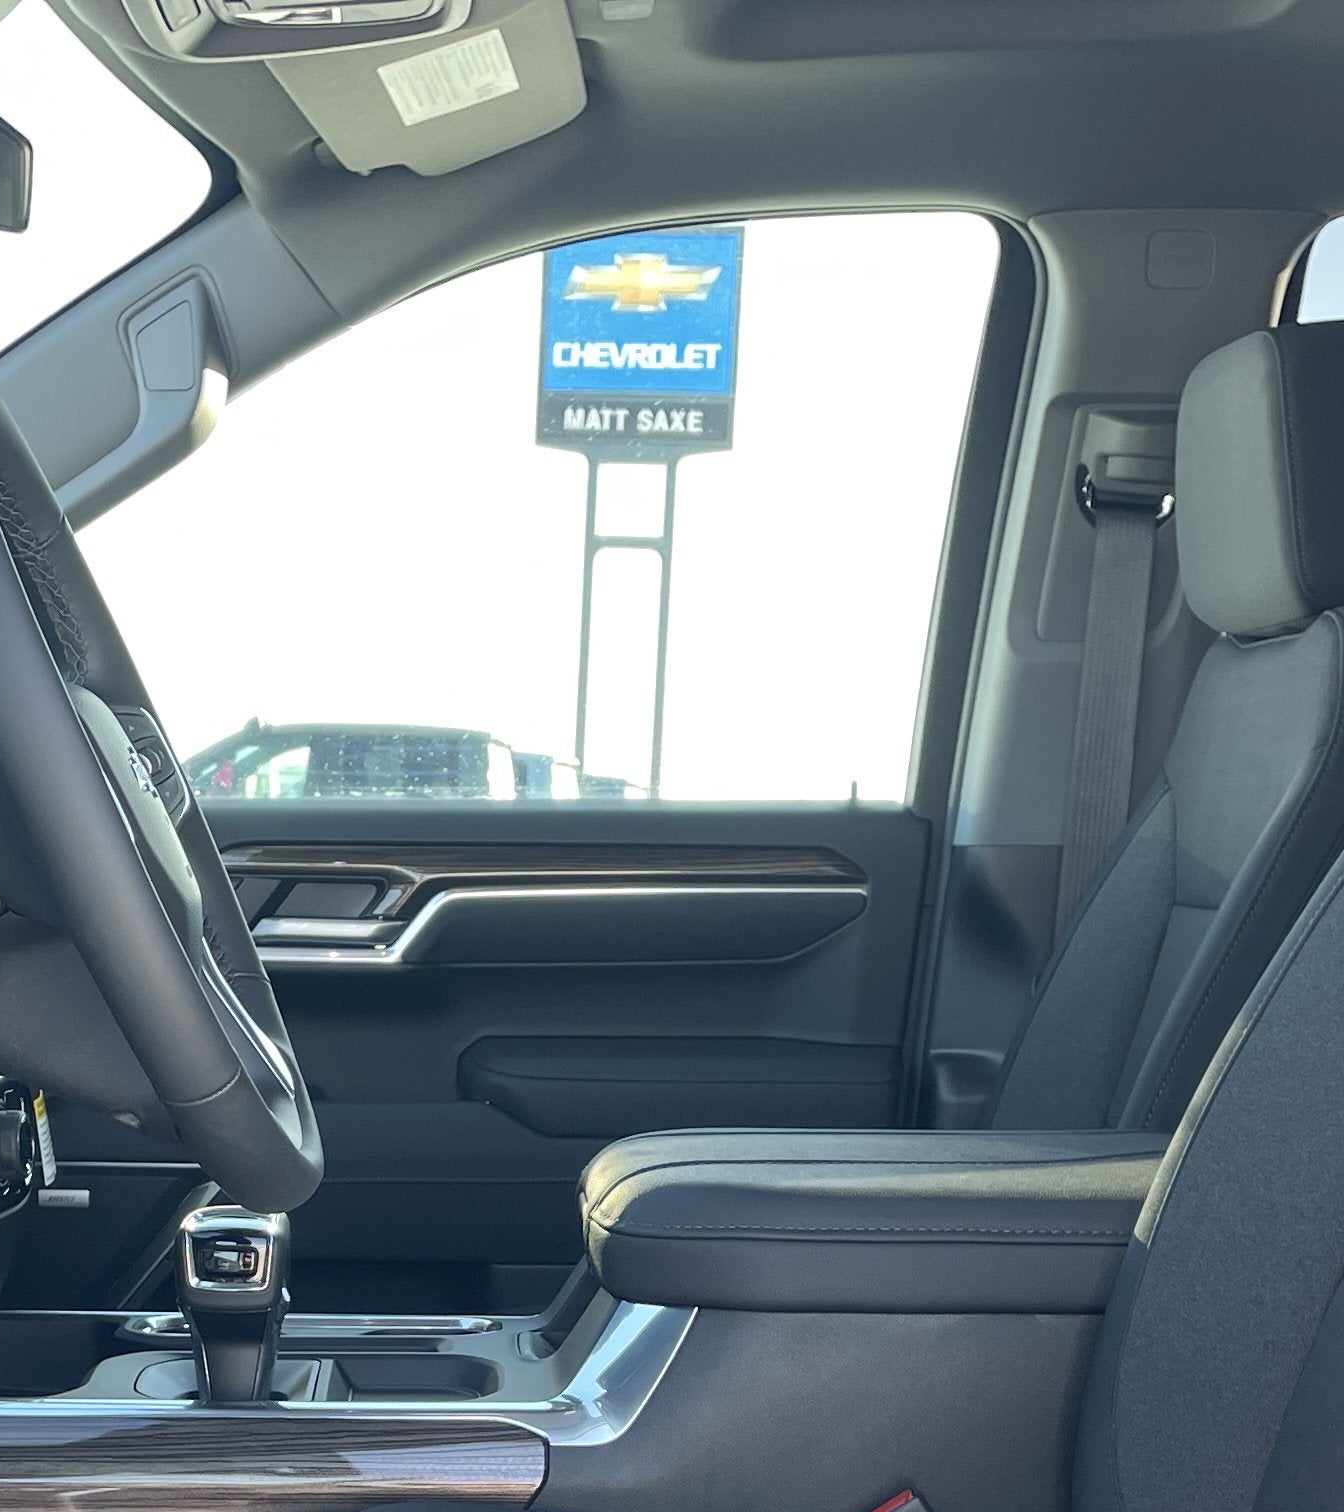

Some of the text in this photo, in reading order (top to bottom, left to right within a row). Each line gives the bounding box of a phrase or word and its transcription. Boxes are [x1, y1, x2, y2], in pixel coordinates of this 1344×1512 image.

[553, 342, 723, 369] CHEVROLET
[563, 405, 704, 433] MATT SAXE
